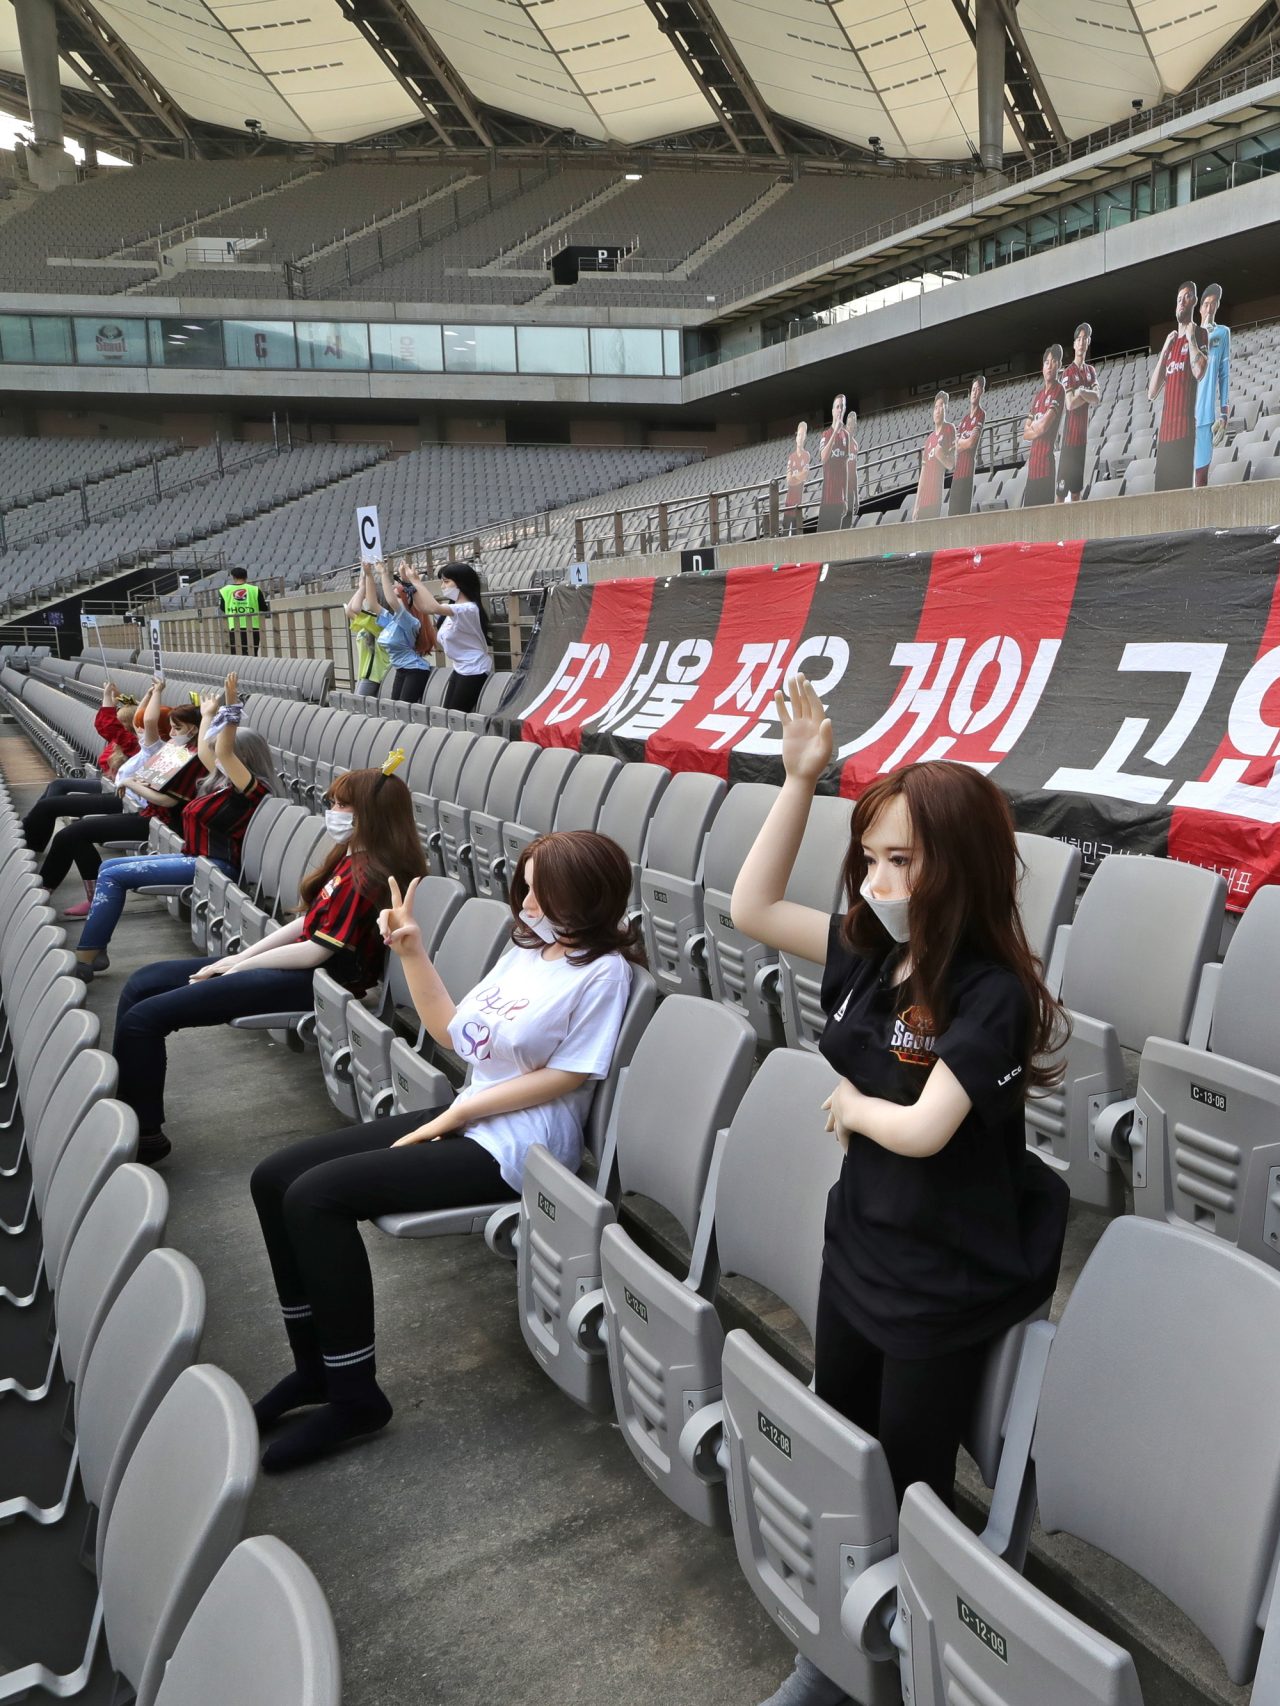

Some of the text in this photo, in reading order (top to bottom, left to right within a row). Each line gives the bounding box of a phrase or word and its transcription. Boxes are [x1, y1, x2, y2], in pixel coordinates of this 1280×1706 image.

[598, 250, 608, 263] P
[361, 515, 376, 549] C
[517, 642, 611, 726] FC
[580, 639, 713, 740] 서울
[694, 635, 850, 756] 작은
[838, 635, 1061, 775] 거인
[891, 1019, 936, 1051] Seou
